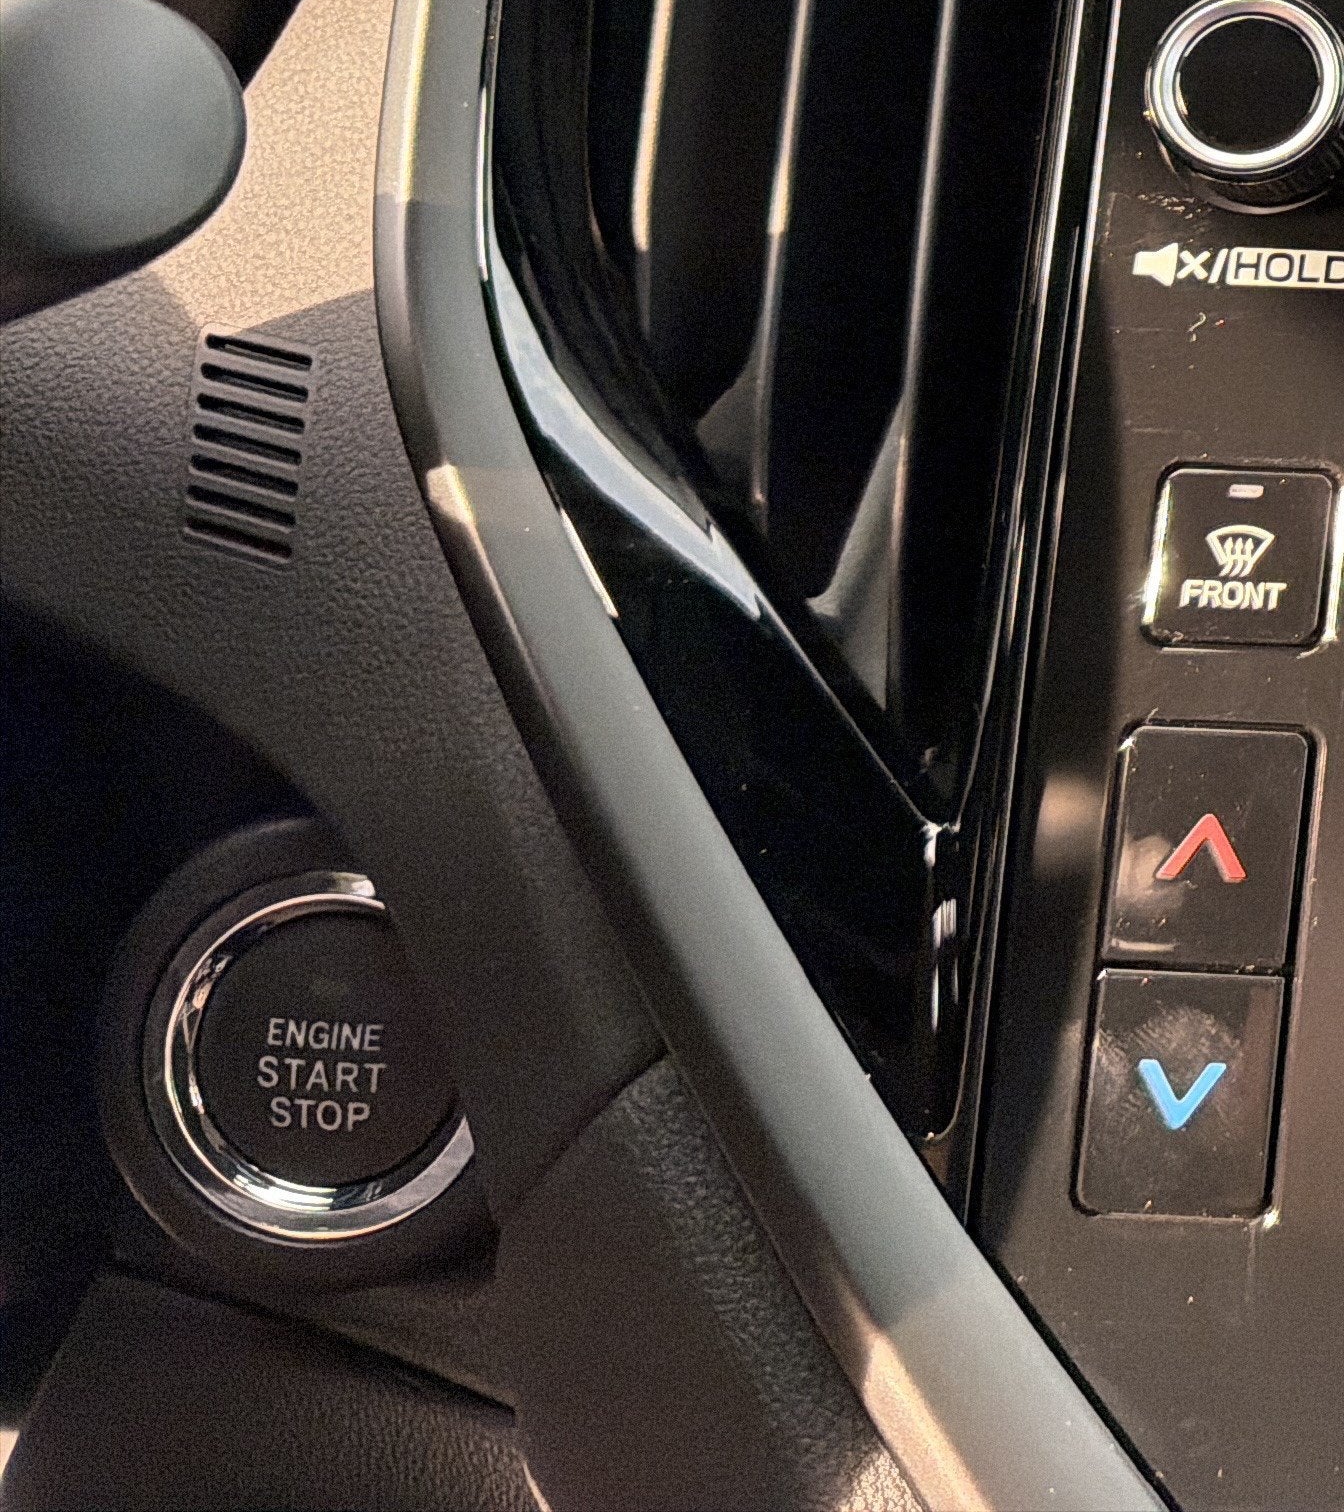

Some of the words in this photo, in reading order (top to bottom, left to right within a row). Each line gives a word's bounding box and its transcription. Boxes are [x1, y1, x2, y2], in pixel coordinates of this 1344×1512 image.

[1179, 579, 1287, 611] FRONT
[267, 1018, 383, 1051] ENGINE
[257, 1055, 386, 1093] START
[270, 1096, 370, 1131] STOP
